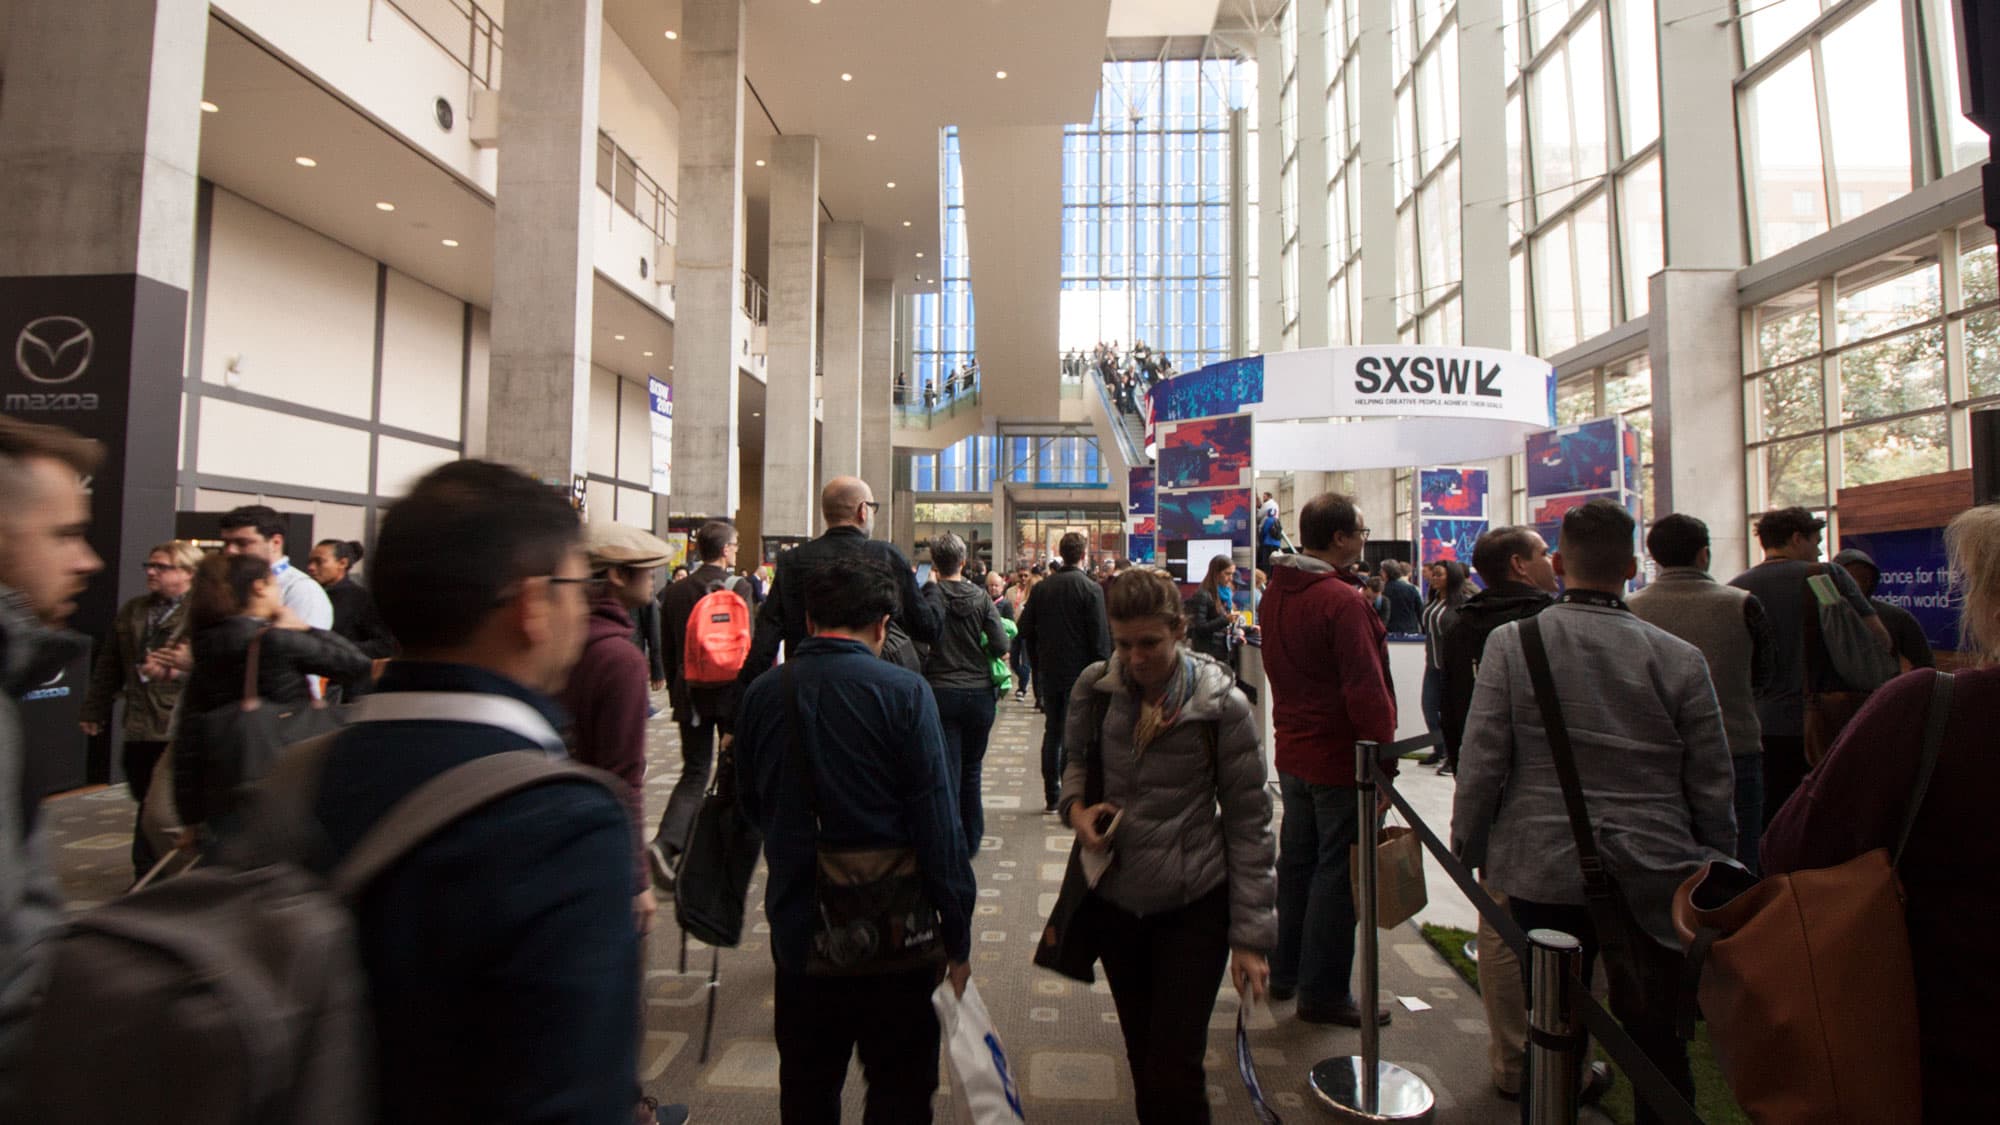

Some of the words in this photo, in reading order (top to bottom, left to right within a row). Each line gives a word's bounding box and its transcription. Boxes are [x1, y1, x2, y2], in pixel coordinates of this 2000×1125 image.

[1355, 357, 1470, 394] SXSW
[1443, 399, 1468, 407] ACHIEVE
[1916, 566, 1934, 584] for
[1912, 590, 1950, 608] world
